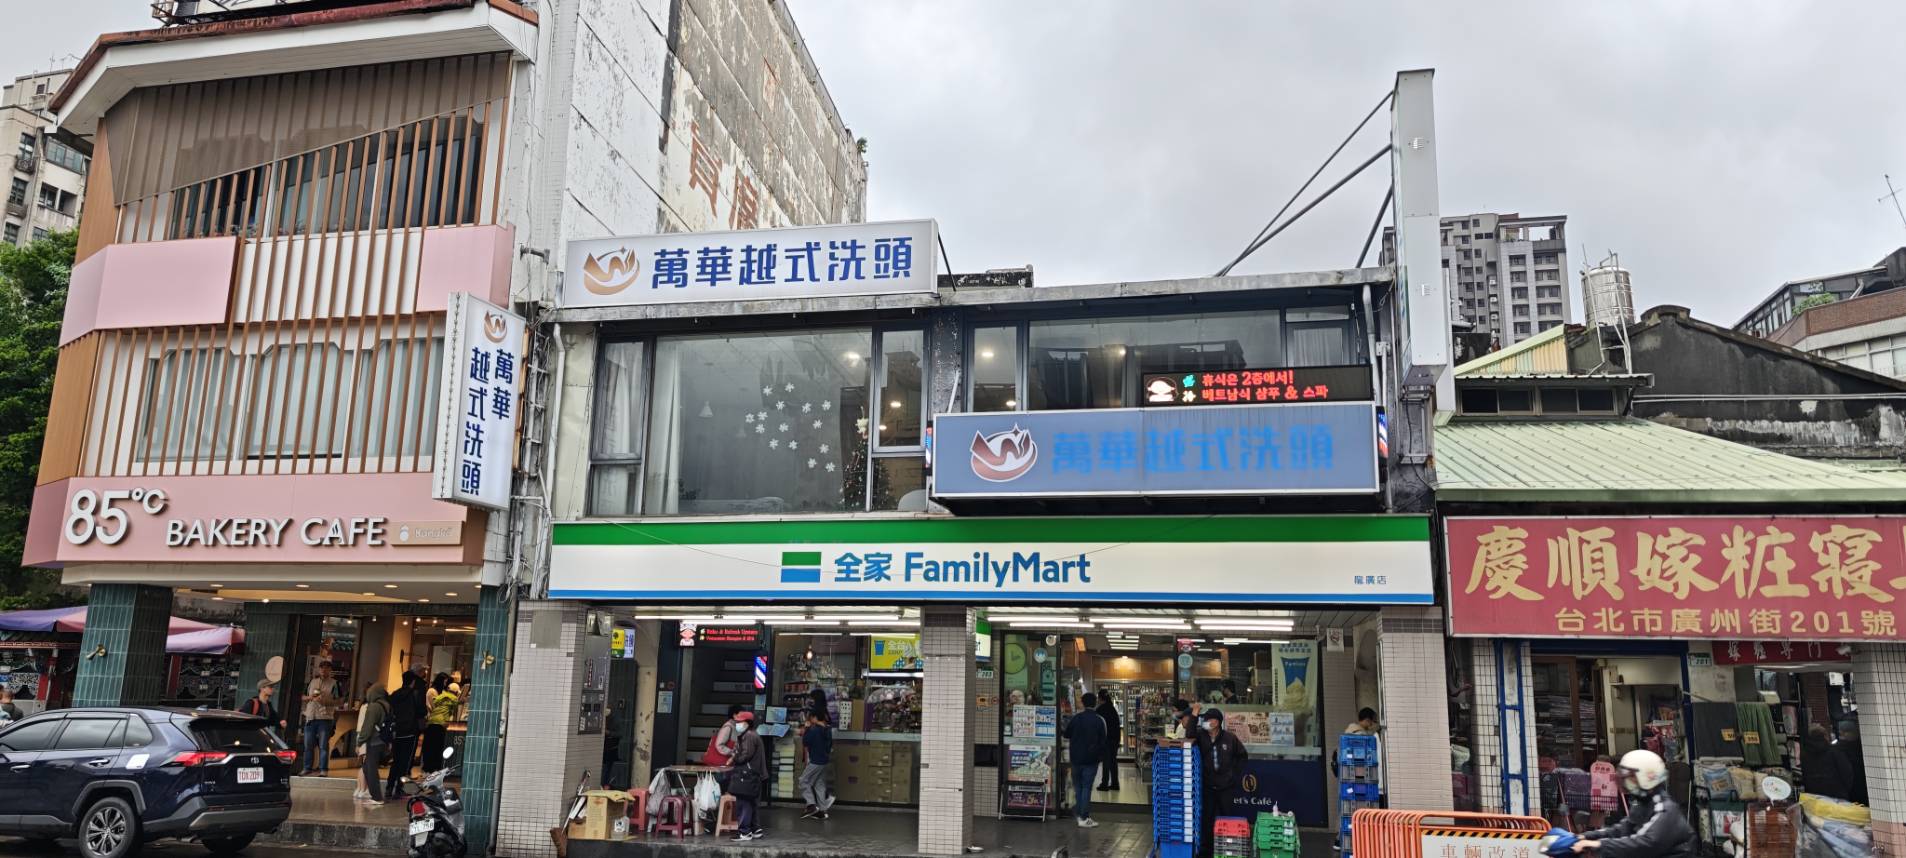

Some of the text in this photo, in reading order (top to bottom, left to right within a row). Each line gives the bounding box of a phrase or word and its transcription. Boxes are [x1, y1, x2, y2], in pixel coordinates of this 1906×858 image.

[651, 236, 913, 289] 萬華越式洗頭
[492, 348, 514, 420] 萬華
[1202, 388, 1250, 401] 베트남식
[1284, 385, 1298, 399] &
[1303, 385, 1328, 398] 스파
[461, 346, 491, 496] 越式洗頭
[1051, 423, 1334, 475] 萬華越式洗頭
[166, 517, 386, 547] BAKERY CAFE
[834, 551, 1091, 587] 全家 FamilyMart
[1464, 525, 1906, 603] 慶順嫁粧寢
[1554, 607, 1897, 636] 台北市廣州街201號
[1233, 797, 1249, 805] et's
